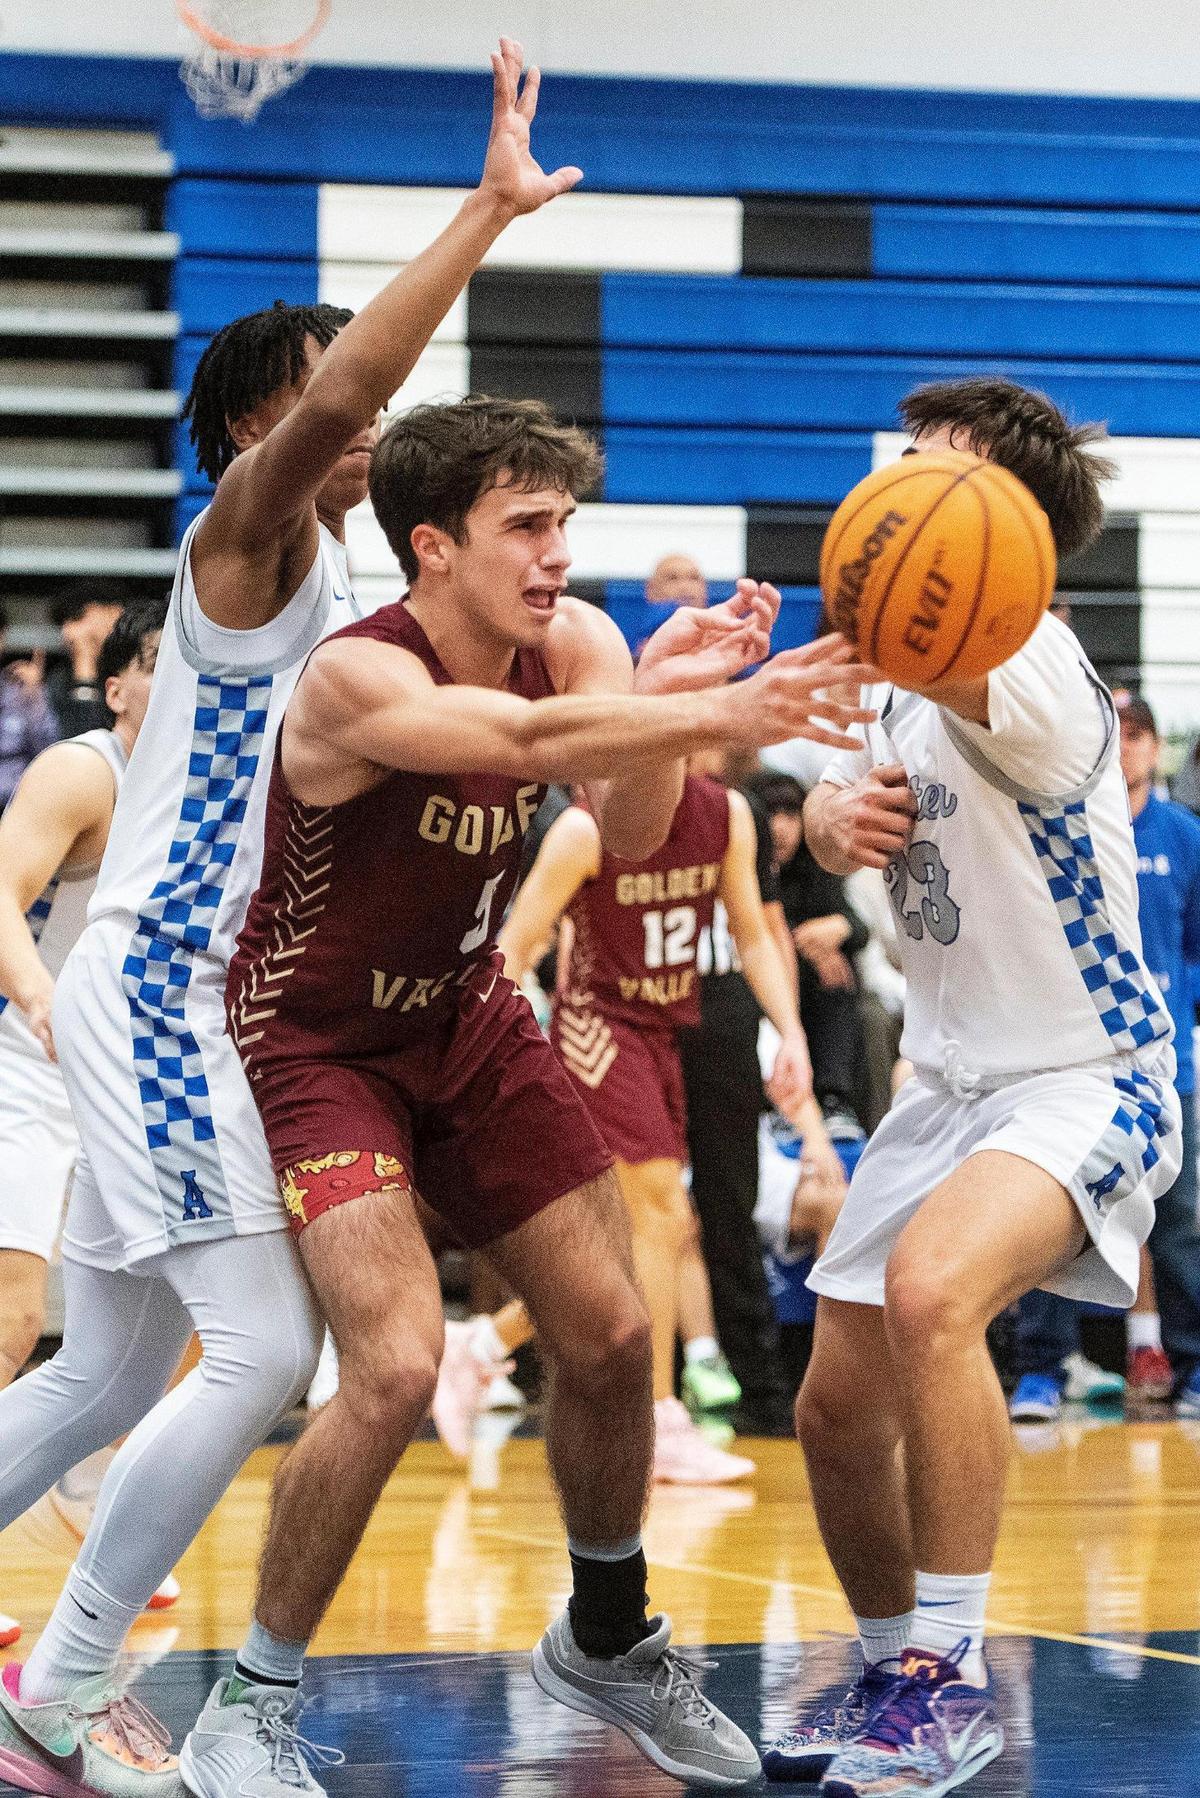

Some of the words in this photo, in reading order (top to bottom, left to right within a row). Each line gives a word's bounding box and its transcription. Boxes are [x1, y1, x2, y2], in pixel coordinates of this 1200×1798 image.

[883, 840, 961, 946] 23
[642, 906, 696, 969] 12
[180, 1169, 213, 1221] A
